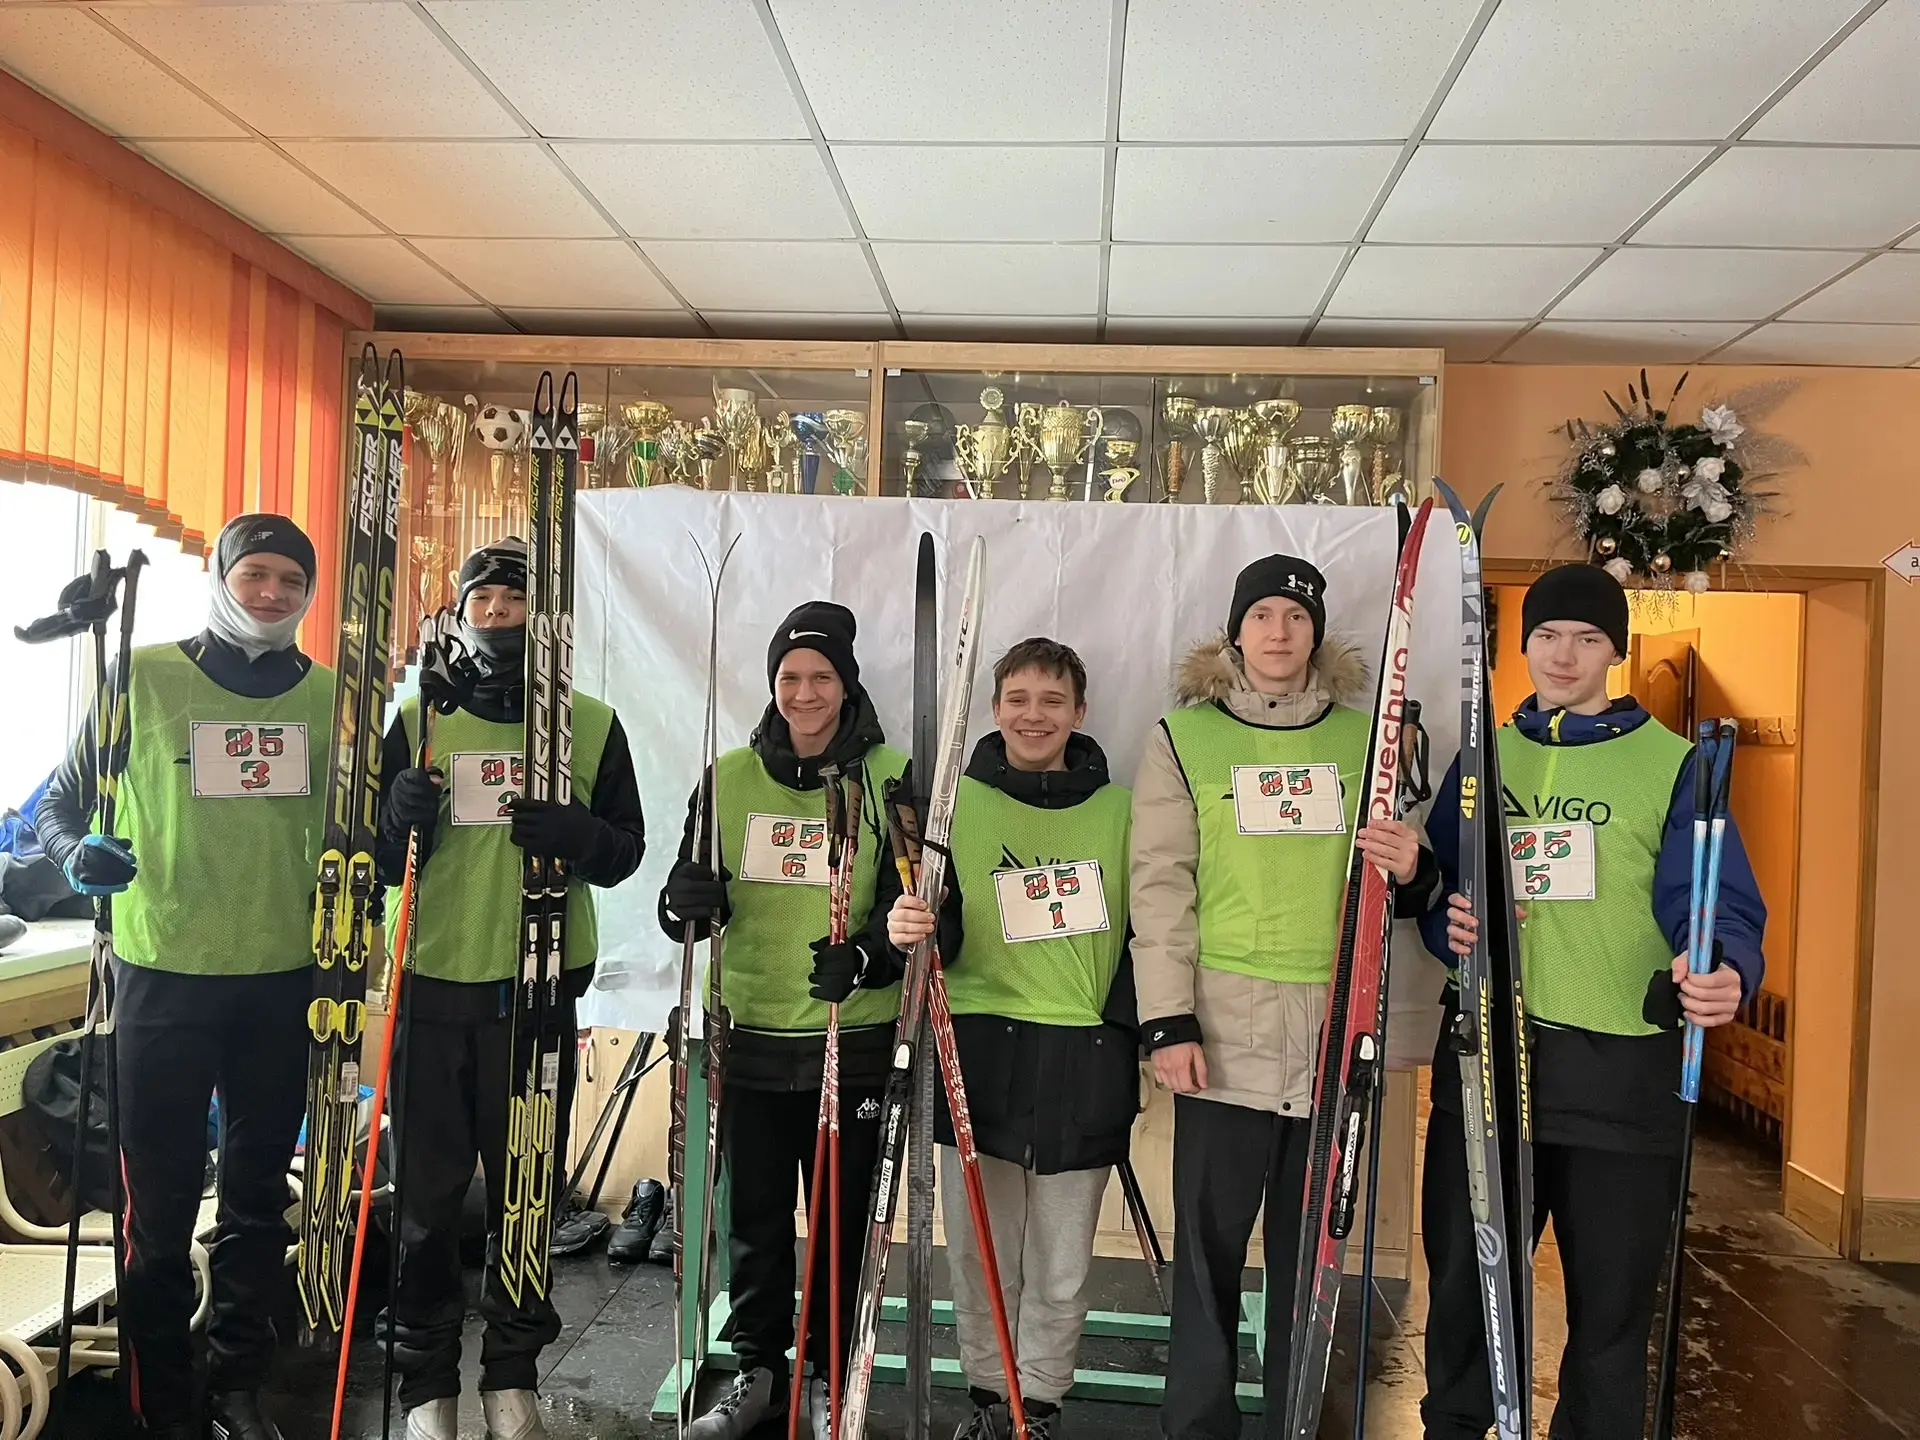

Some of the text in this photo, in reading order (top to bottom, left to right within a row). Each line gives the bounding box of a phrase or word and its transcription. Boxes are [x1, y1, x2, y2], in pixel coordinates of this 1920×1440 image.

[359, 433, 378, 537] FISCHER
[385, 438, 402, 541] FISCHER
[530, 453, 540, 522] FISCHER
[555, 453, 565, 522] FISCHER
[956, 619, 969, 668] STC
[1470, 652, 1481, 749] DYNAMIC
[225, 727, 284, 757] 85
[240, 760, 270, 790] 3
[1259, 769, 1313, 797] 85
[1280, 801, 1302, 825] 4
[1533, 794, 1612, 826] VIGO
[771, 822, 825, 849] 85
[1510, 830, 1572, 860] 85
[782, 853, 807, 878] 6
[1525, 864, 1551, 895] 5
[1023, 867, 1081, 900] 85
[1048, 901, 1067, 929] 1
[680, 1012, 689, 1061] STC
[1479, 976, 1492, 1123] DYNAMIC
[1515, 994, 1532, 1142] DYNAMIC
[1485, 1273, 1506, 1394] DYNAMIC
